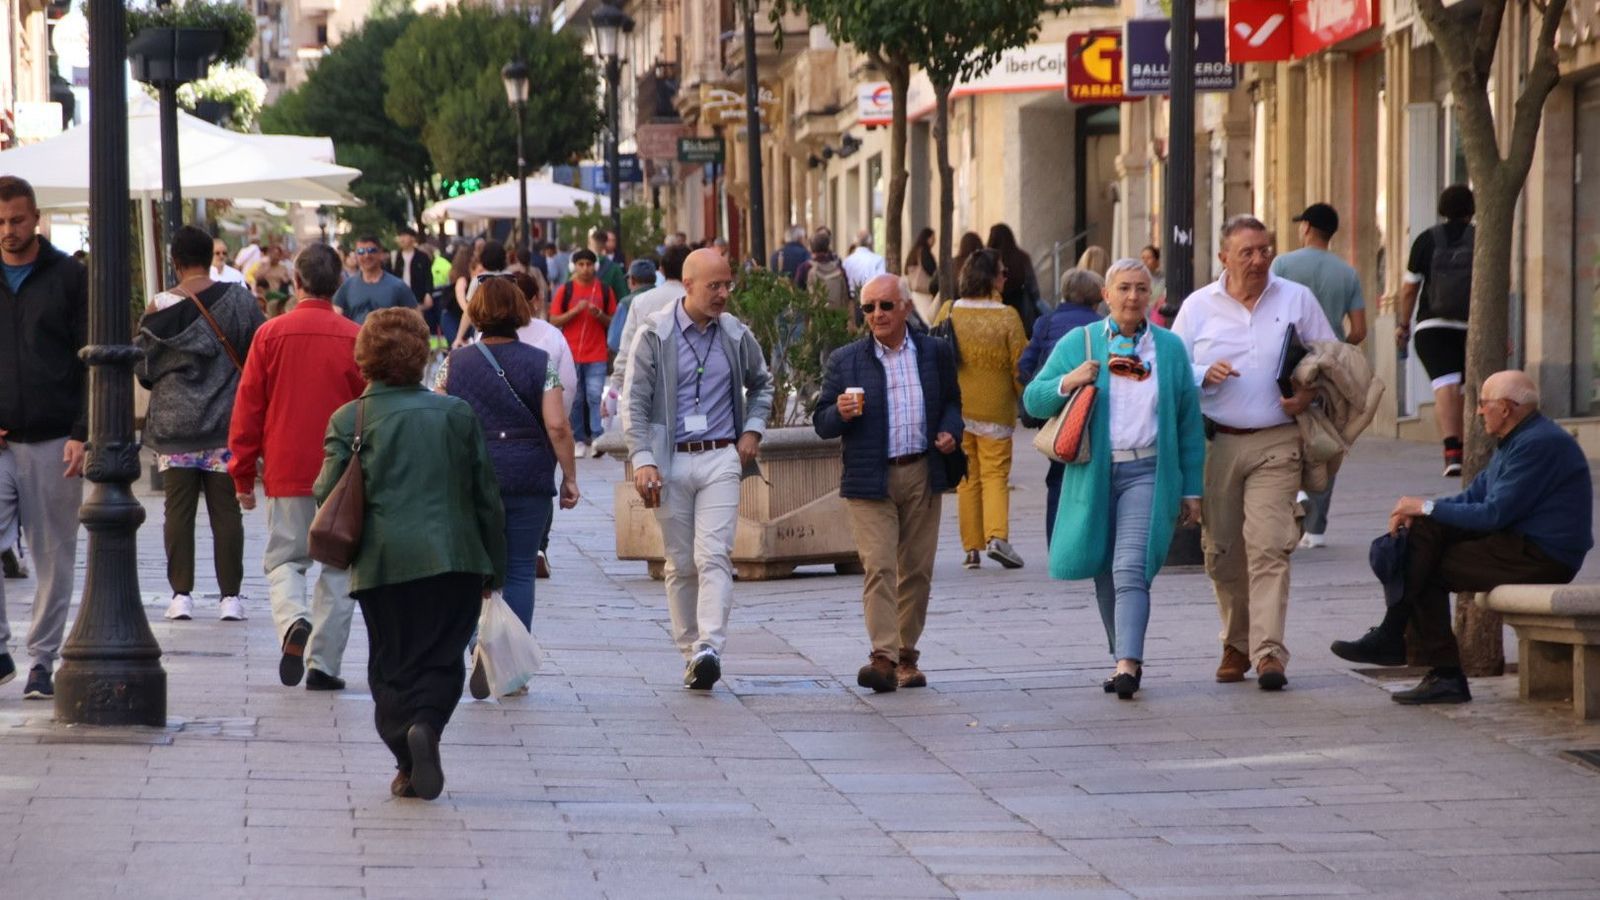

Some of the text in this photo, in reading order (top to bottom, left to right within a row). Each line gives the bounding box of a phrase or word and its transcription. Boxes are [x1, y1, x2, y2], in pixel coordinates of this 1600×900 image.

[1005, 53, 1066, 75] iberCaj
[1132, 61, 1233, 77] BALLEROS
[1072, 83, 1122, 98] TABAC
